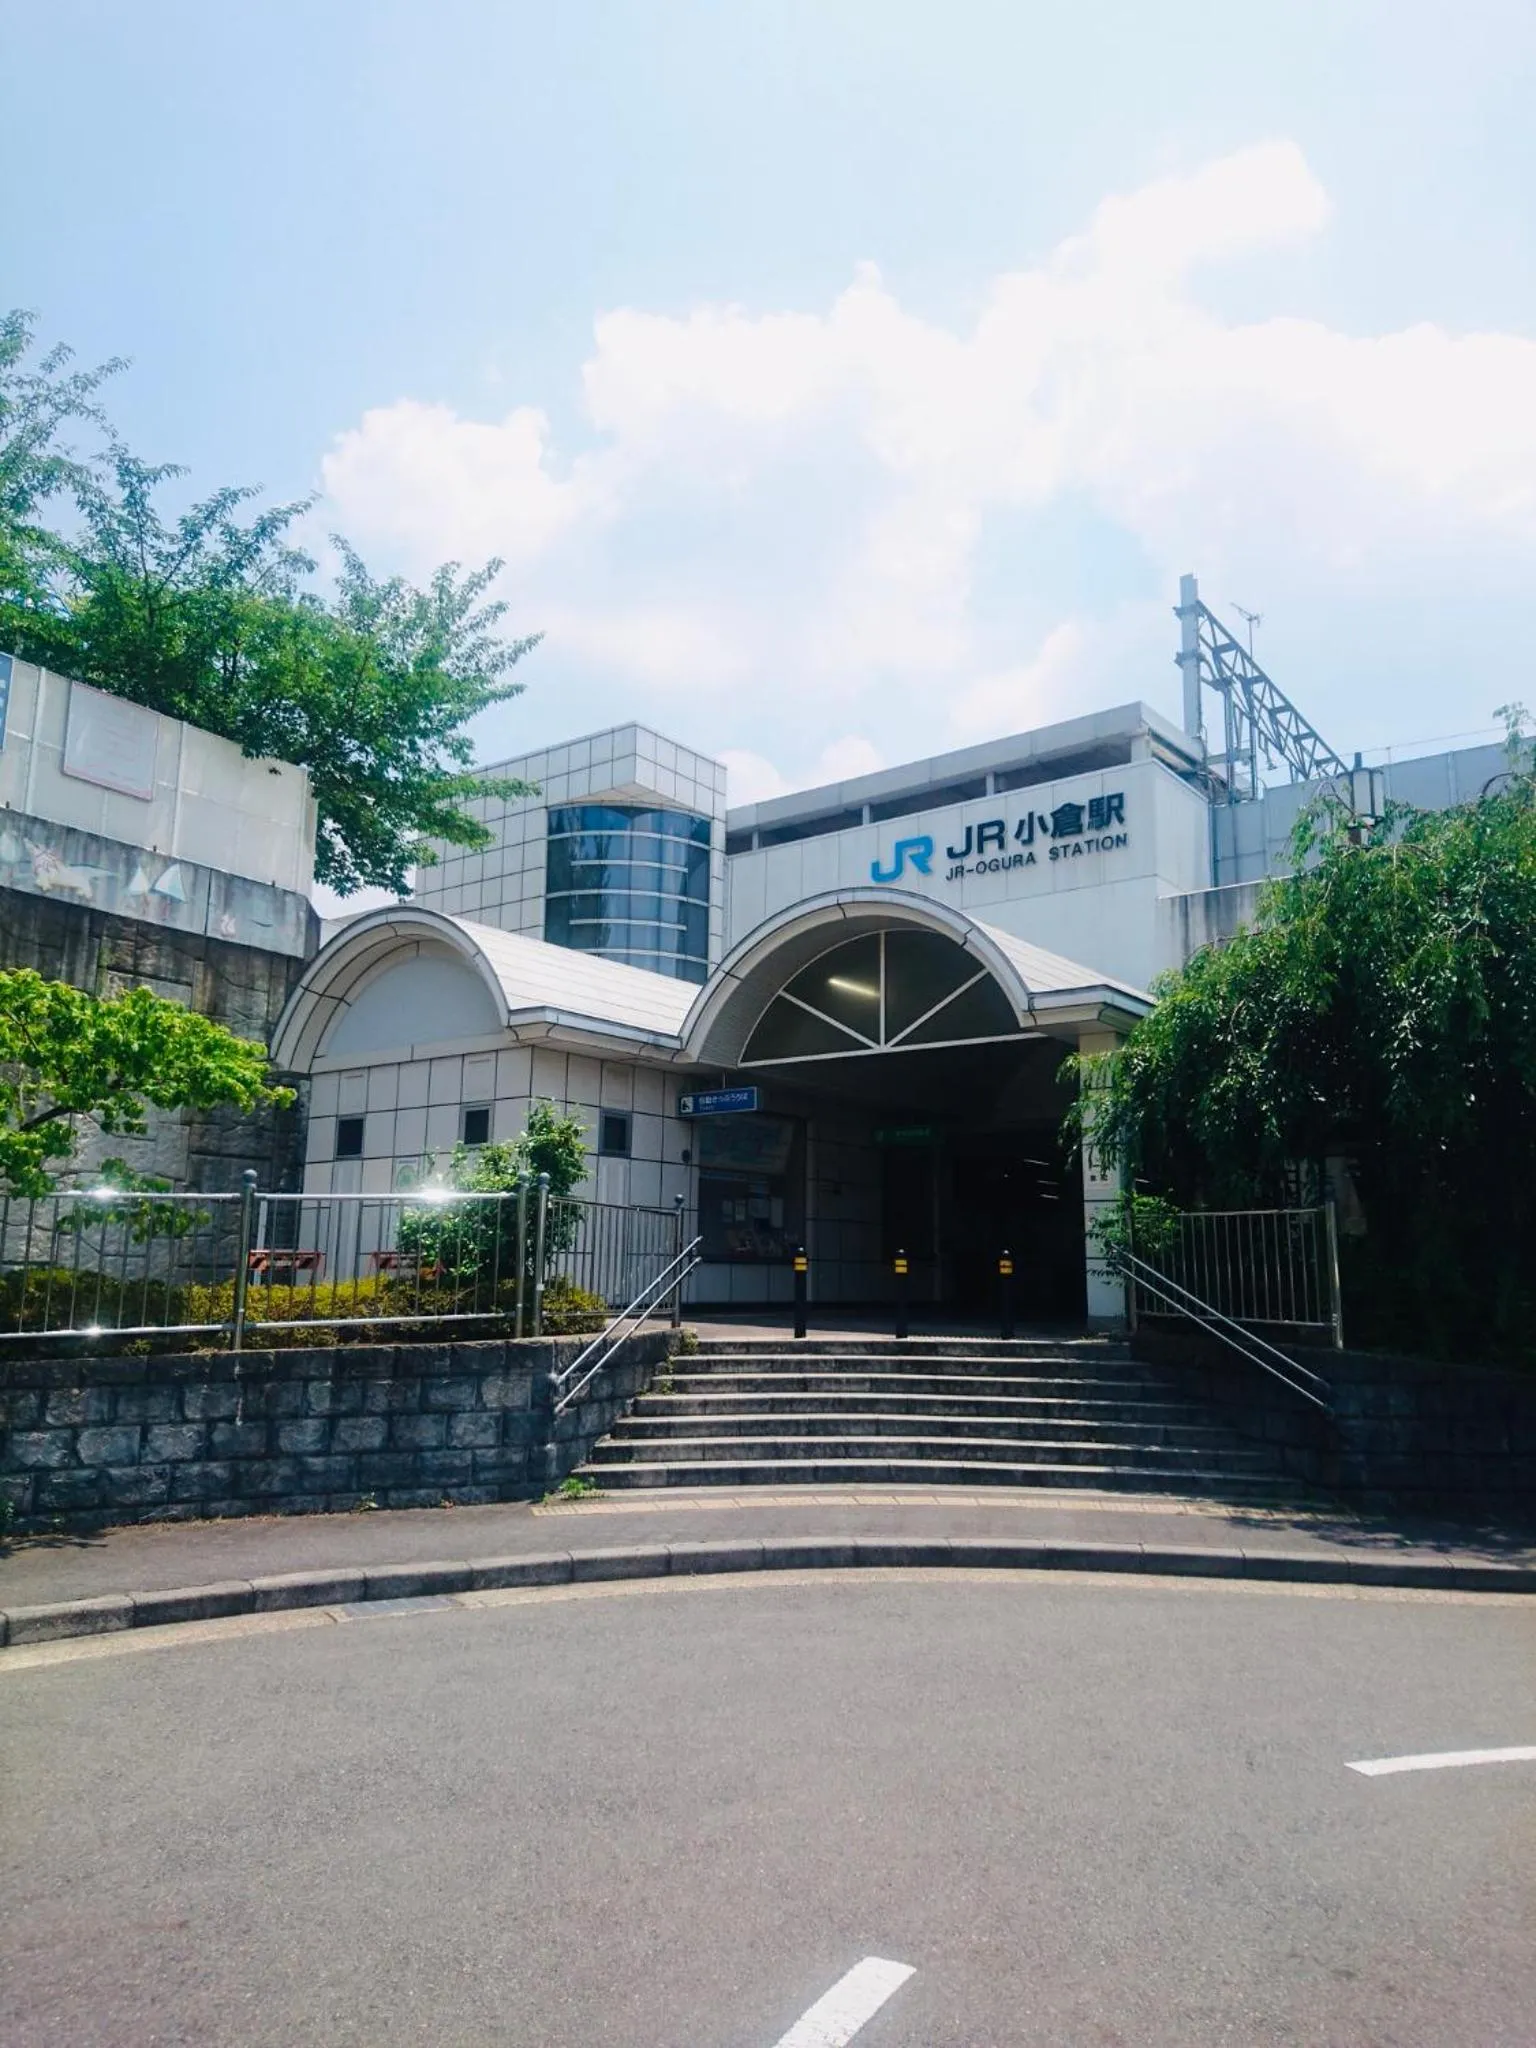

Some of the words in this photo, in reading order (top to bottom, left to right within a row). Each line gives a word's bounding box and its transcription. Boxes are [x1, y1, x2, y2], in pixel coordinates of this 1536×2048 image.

[871, 835, 934, 883] JR
[945, 851, 1037, 881] JR-OGURA
[1048, 832, 1128, 861] STATION
